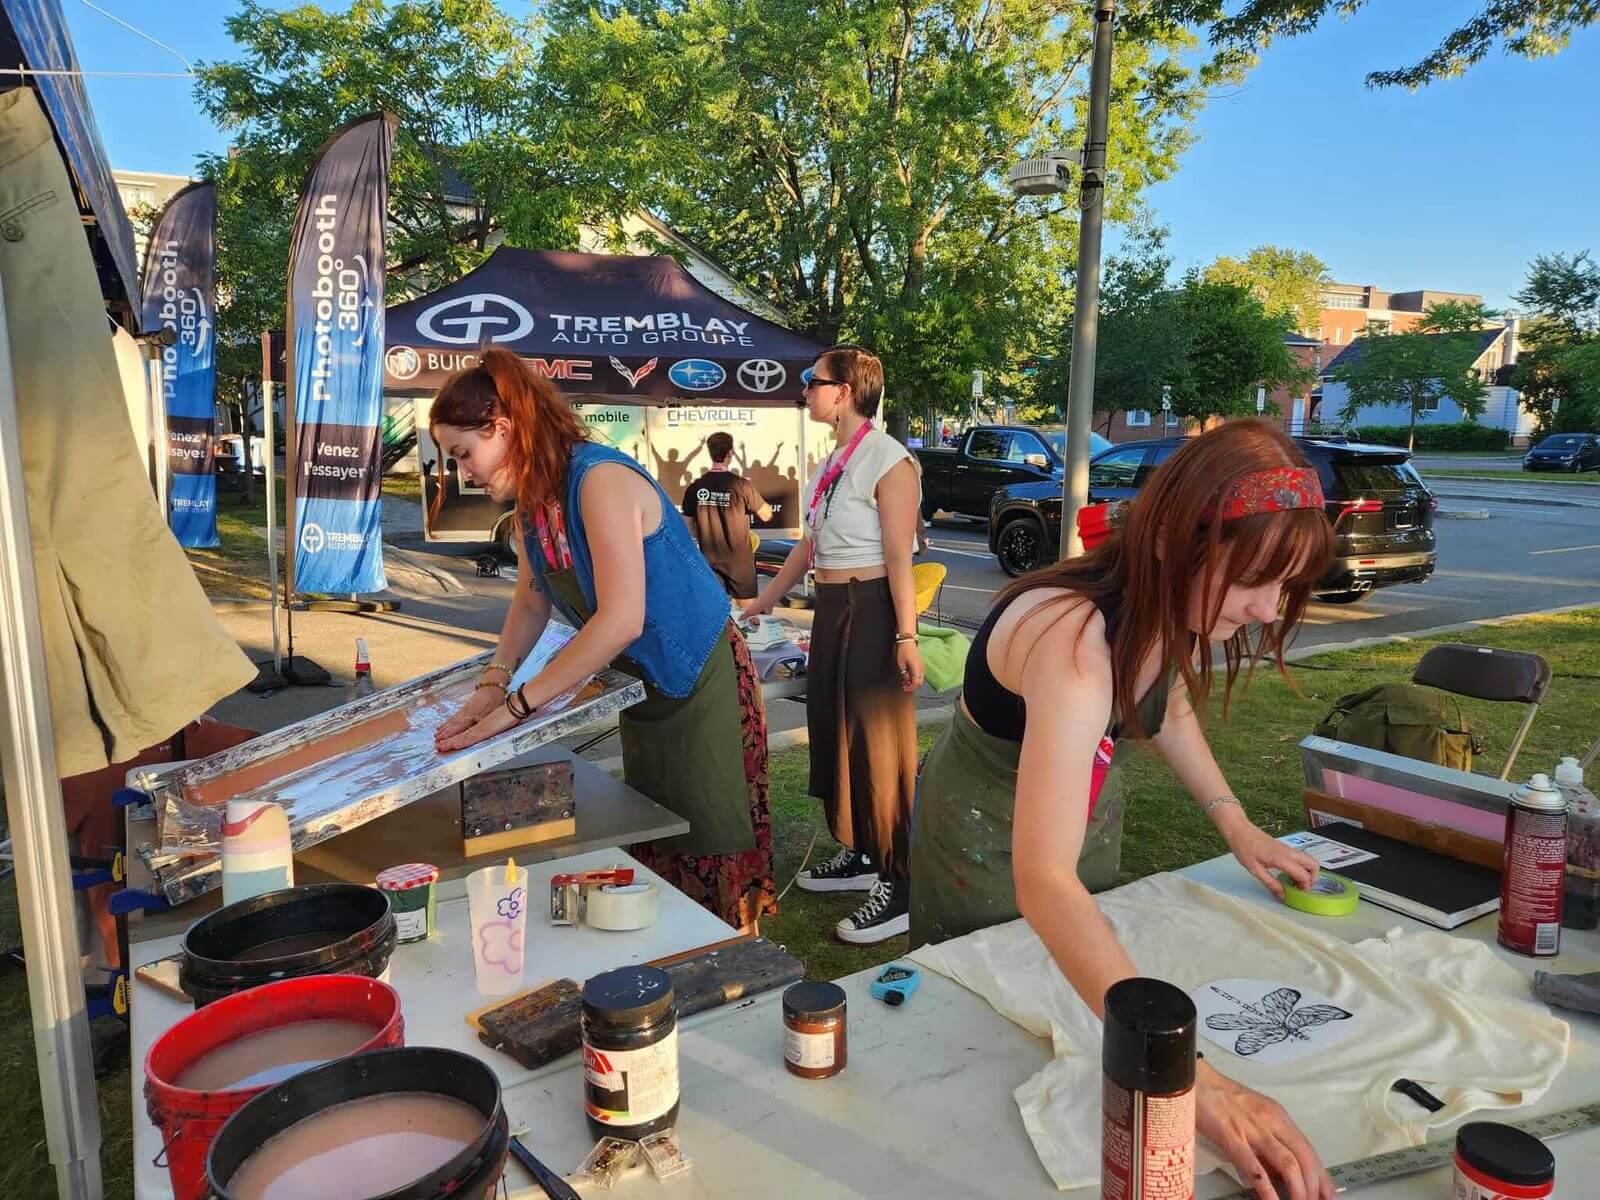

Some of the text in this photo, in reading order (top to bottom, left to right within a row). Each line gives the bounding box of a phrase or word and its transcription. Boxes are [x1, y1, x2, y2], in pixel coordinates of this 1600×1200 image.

[312, 194, 337, 402] Photobooth
[549, 312, 749, 336] TREMBLAY
[551, 329, 754, 347] AUTO GROUPE
[427, 353, 484, 371] BUIC
[520, 357, 593, 380] MC
[585, 411, 630, 423] mobile
[667, 409, 757, 422] CHEVROLET
[170, 431, 201, 443] enez
[317, 442, 359, 458] Venez
